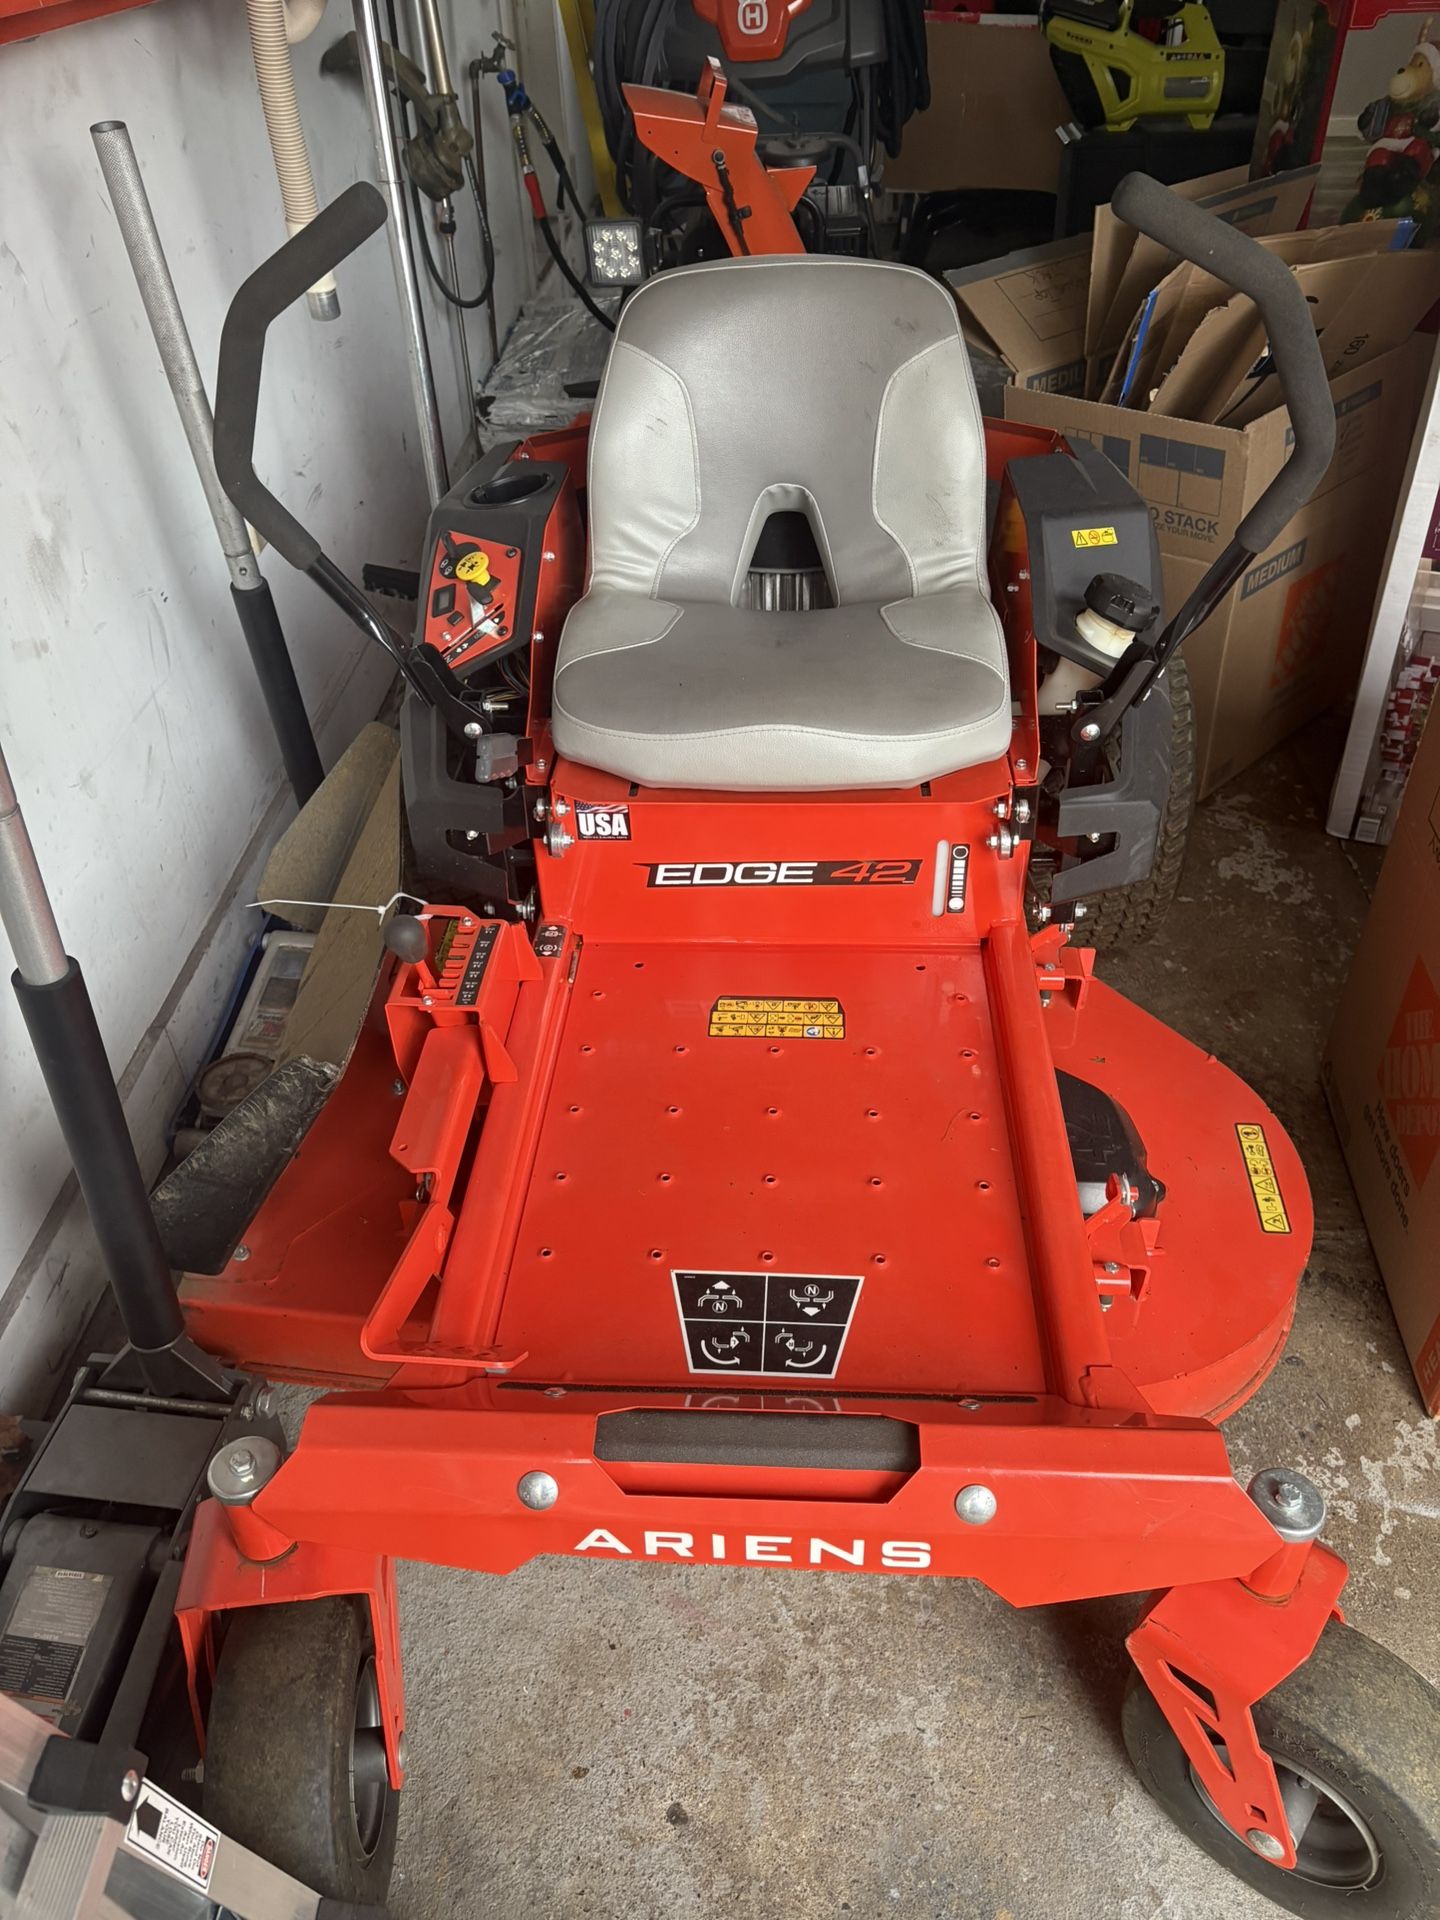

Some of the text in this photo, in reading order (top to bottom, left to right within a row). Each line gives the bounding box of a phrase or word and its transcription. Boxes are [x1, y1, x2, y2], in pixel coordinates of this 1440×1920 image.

[1164, 510, 1219, 536] STACK
[1246, 544, 1304, 593] MEDIUM
[578, 812, 629, 836] USA
[655, 860, 913, 886] EDGE 42
[1384, 1043, 1440, 1099] HOM
[1389, 1143, 1410, 1198] doers
[574, 1528, 932, 1569] ARIENS
